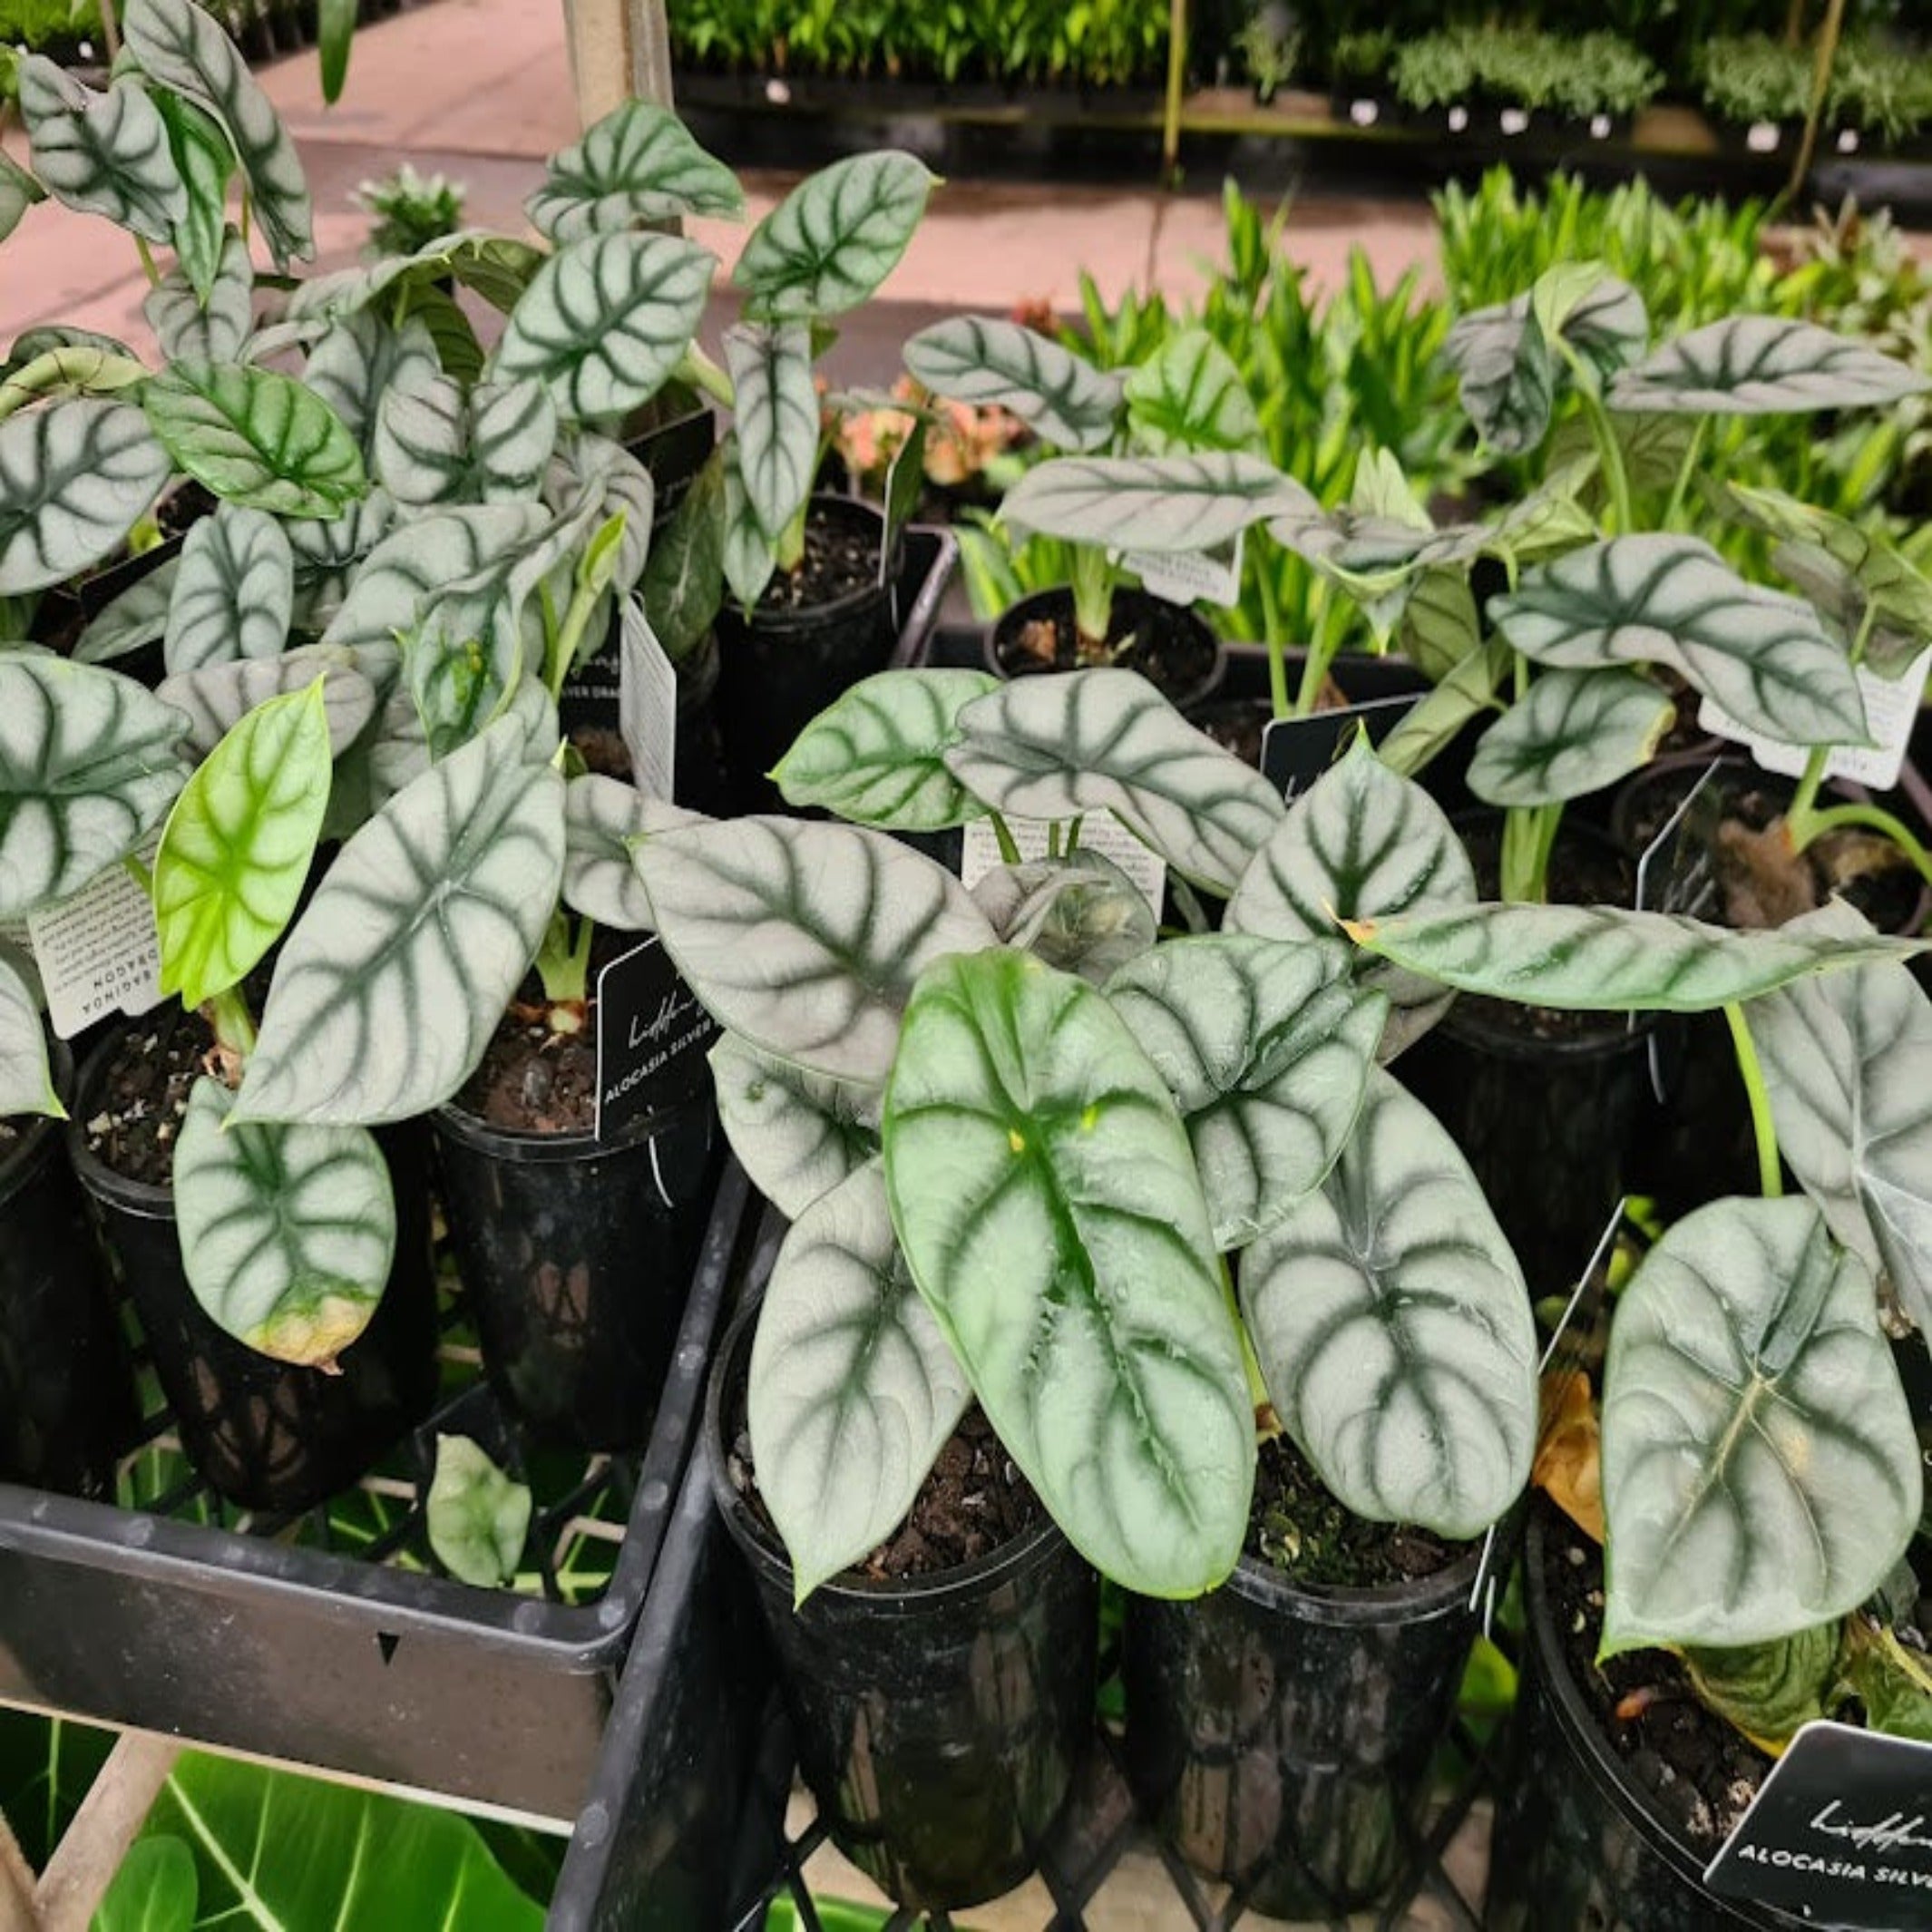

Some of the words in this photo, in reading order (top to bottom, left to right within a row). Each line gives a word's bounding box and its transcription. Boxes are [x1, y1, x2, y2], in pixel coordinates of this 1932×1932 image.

[604, 1049, 668, 1104] ALOCASIA
[669, 1020, 712, 1056] SILVER
[1738, 1843, 1866, 1880] ALOCASIA
